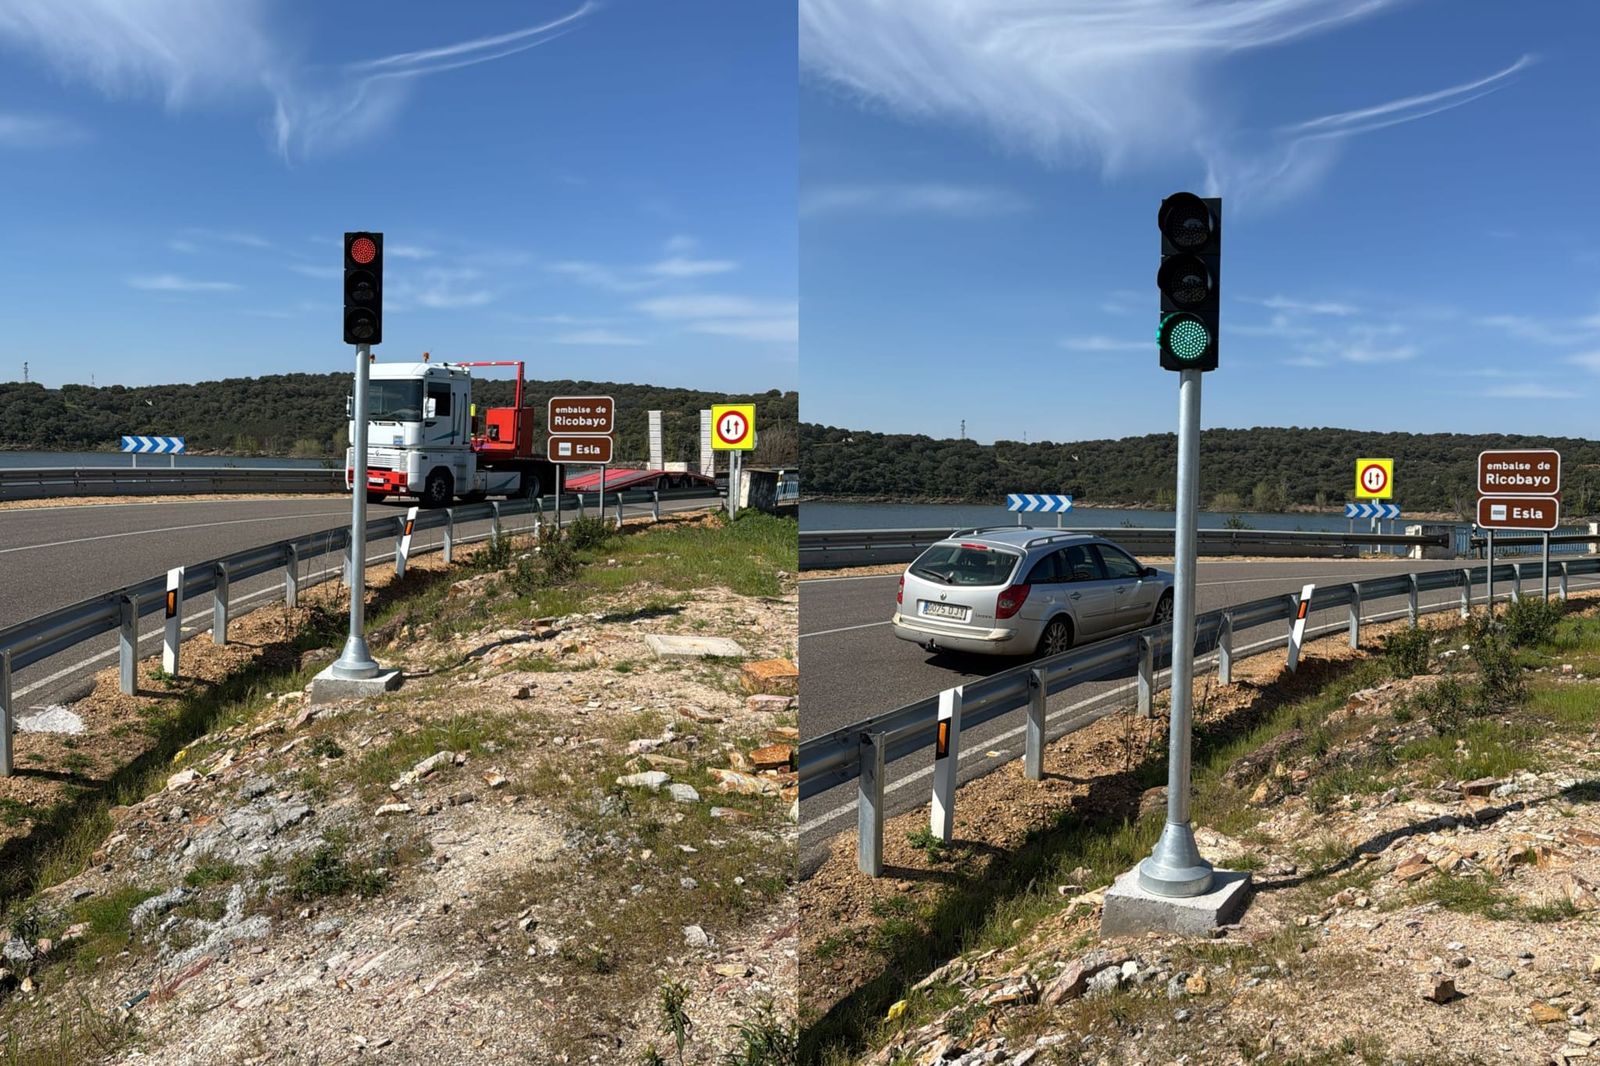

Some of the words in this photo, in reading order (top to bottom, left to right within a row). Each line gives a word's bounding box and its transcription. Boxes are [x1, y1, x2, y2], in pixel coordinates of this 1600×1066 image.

[555, 406, 591, 414] embalse
[595, 406, 607, 414] de
[554, 416, 607, 428] Ricobayo
[576, 444, 601, 455] Esla
[1486, 461, 1531, 471] embalse
[1537, 461, 1551, 471] de
[1485, 473, 1551, 487] Ricobayo
[1512, 507, 1543, 520] Esla
